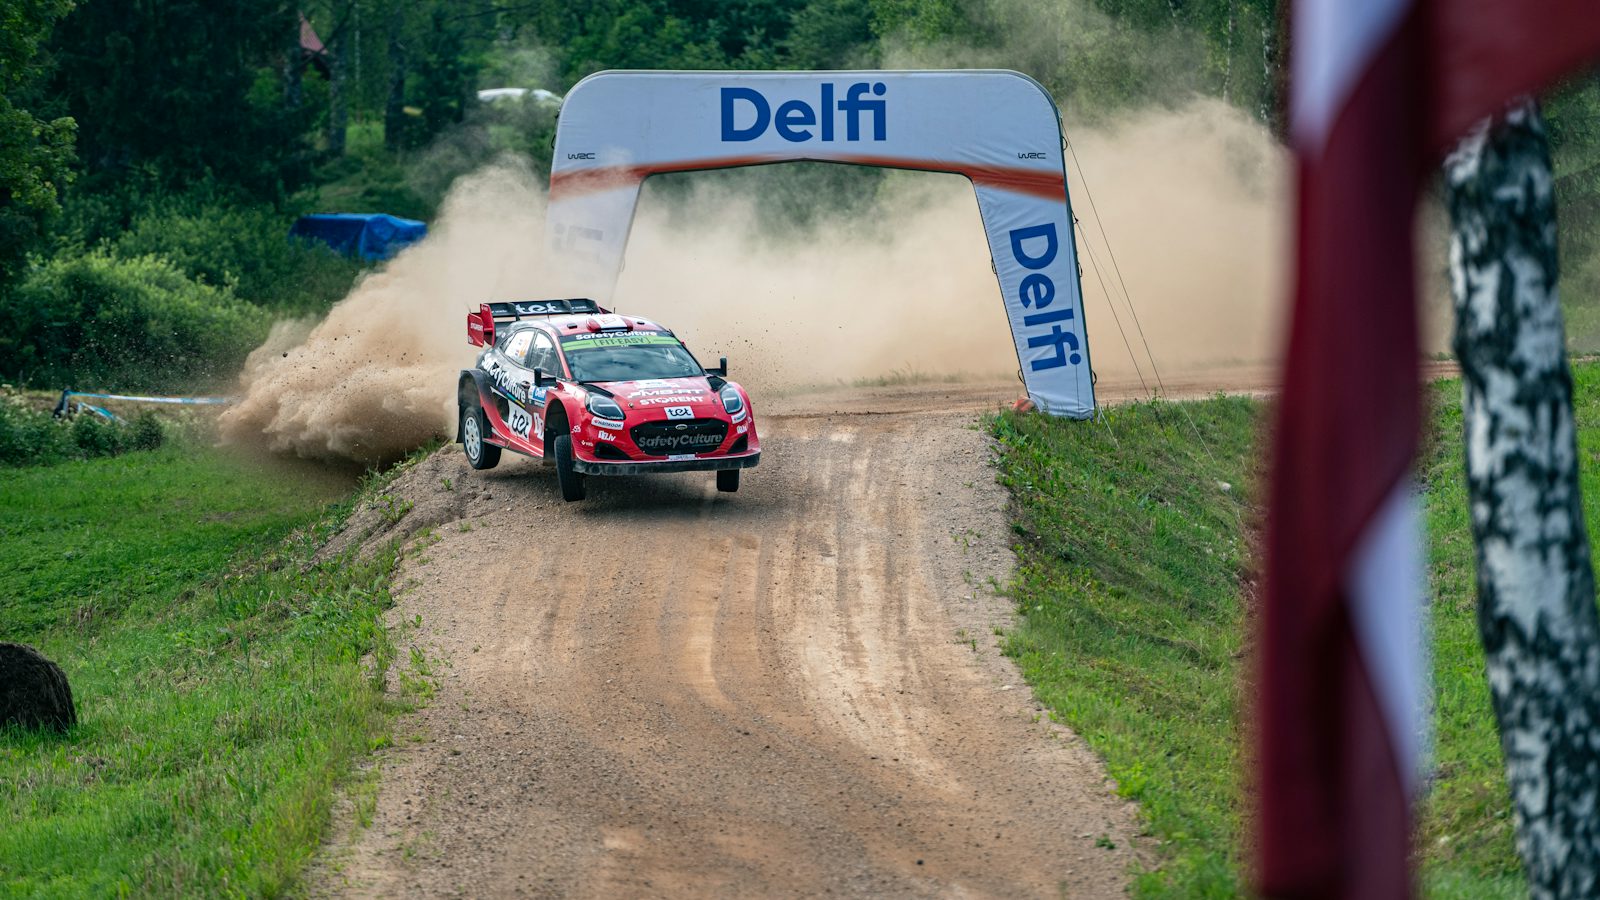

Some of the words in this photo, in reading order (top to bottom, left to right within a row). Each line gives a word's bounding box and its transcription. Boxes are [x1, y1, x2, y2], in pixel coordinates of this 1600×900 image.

[720, 82, 887, 142] Delfi
[567, 152, 596, 160] WRC
[1017, 152, 1047, 160] WRC
[1009, 222, 1082, 372] Delfi
[516, 302, 562, 314] tet
[575, 330, 658, 340] SafetyCulture
[640, 396, 704, 405] STORENT
[668, 408, 692, 417] tet
[511, 409, 530, 439] tet
[638, 434, 723, 449] SafetyCulture
